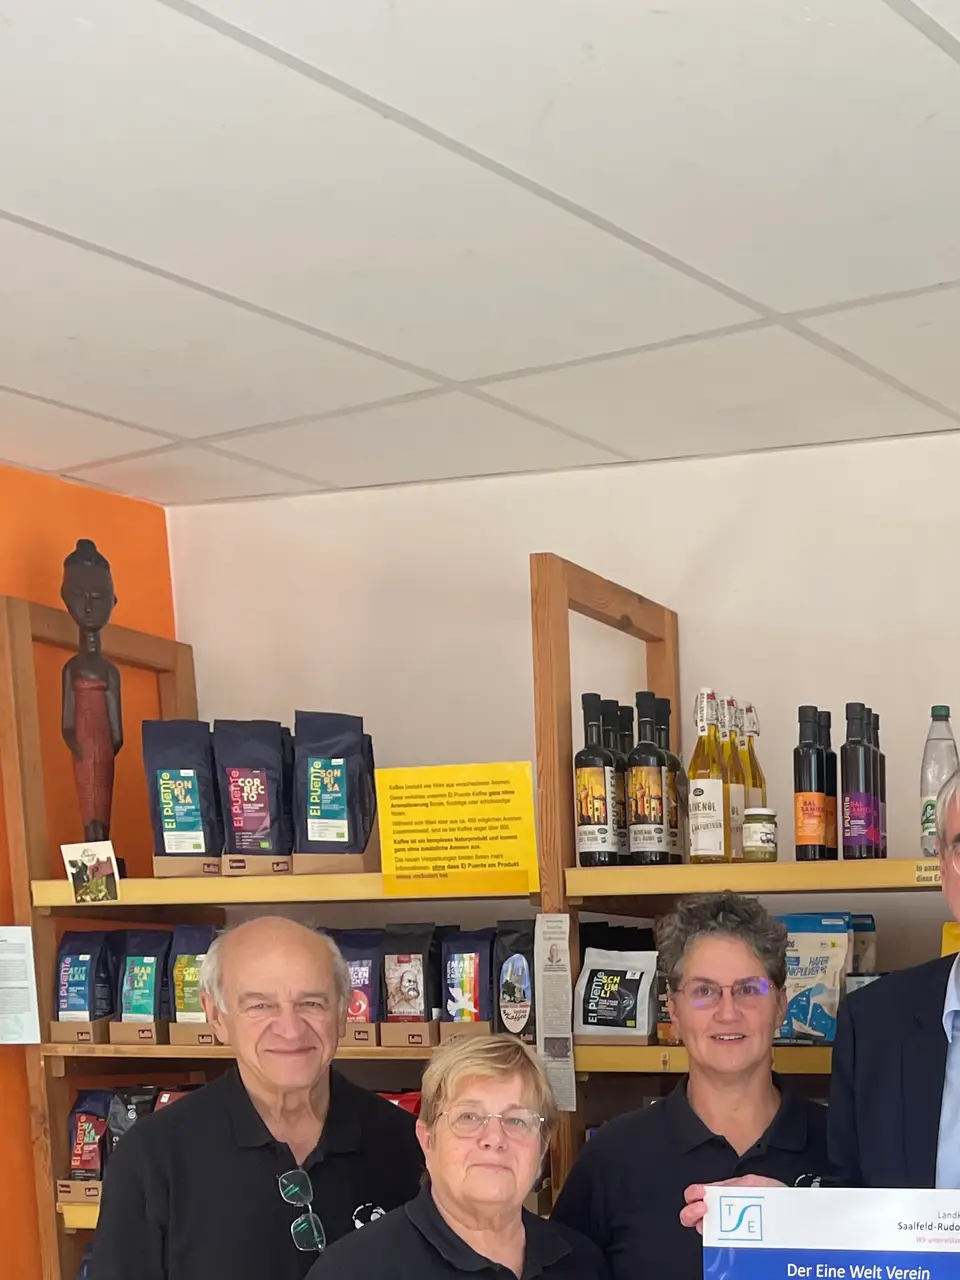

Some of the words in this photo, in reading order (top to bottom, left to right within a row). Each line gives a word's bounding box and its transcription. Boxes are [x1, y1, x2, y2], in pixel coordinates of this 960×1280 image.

[238, 778, 261, 786] COR
[244, 785, 265, 794] REC
[326, 784, 340, 792] SA
[241, 793, 258, 802] TO
[602, 976, 620, 984] SCH
[601, 990, 610, 998] LI
[787, 1264, 812, 1277] Der
[816, 1264, 845, 1279] Eine
[850, 1265, 882, 1280] Welt
[886, 1266, 930, 1280] Verein
